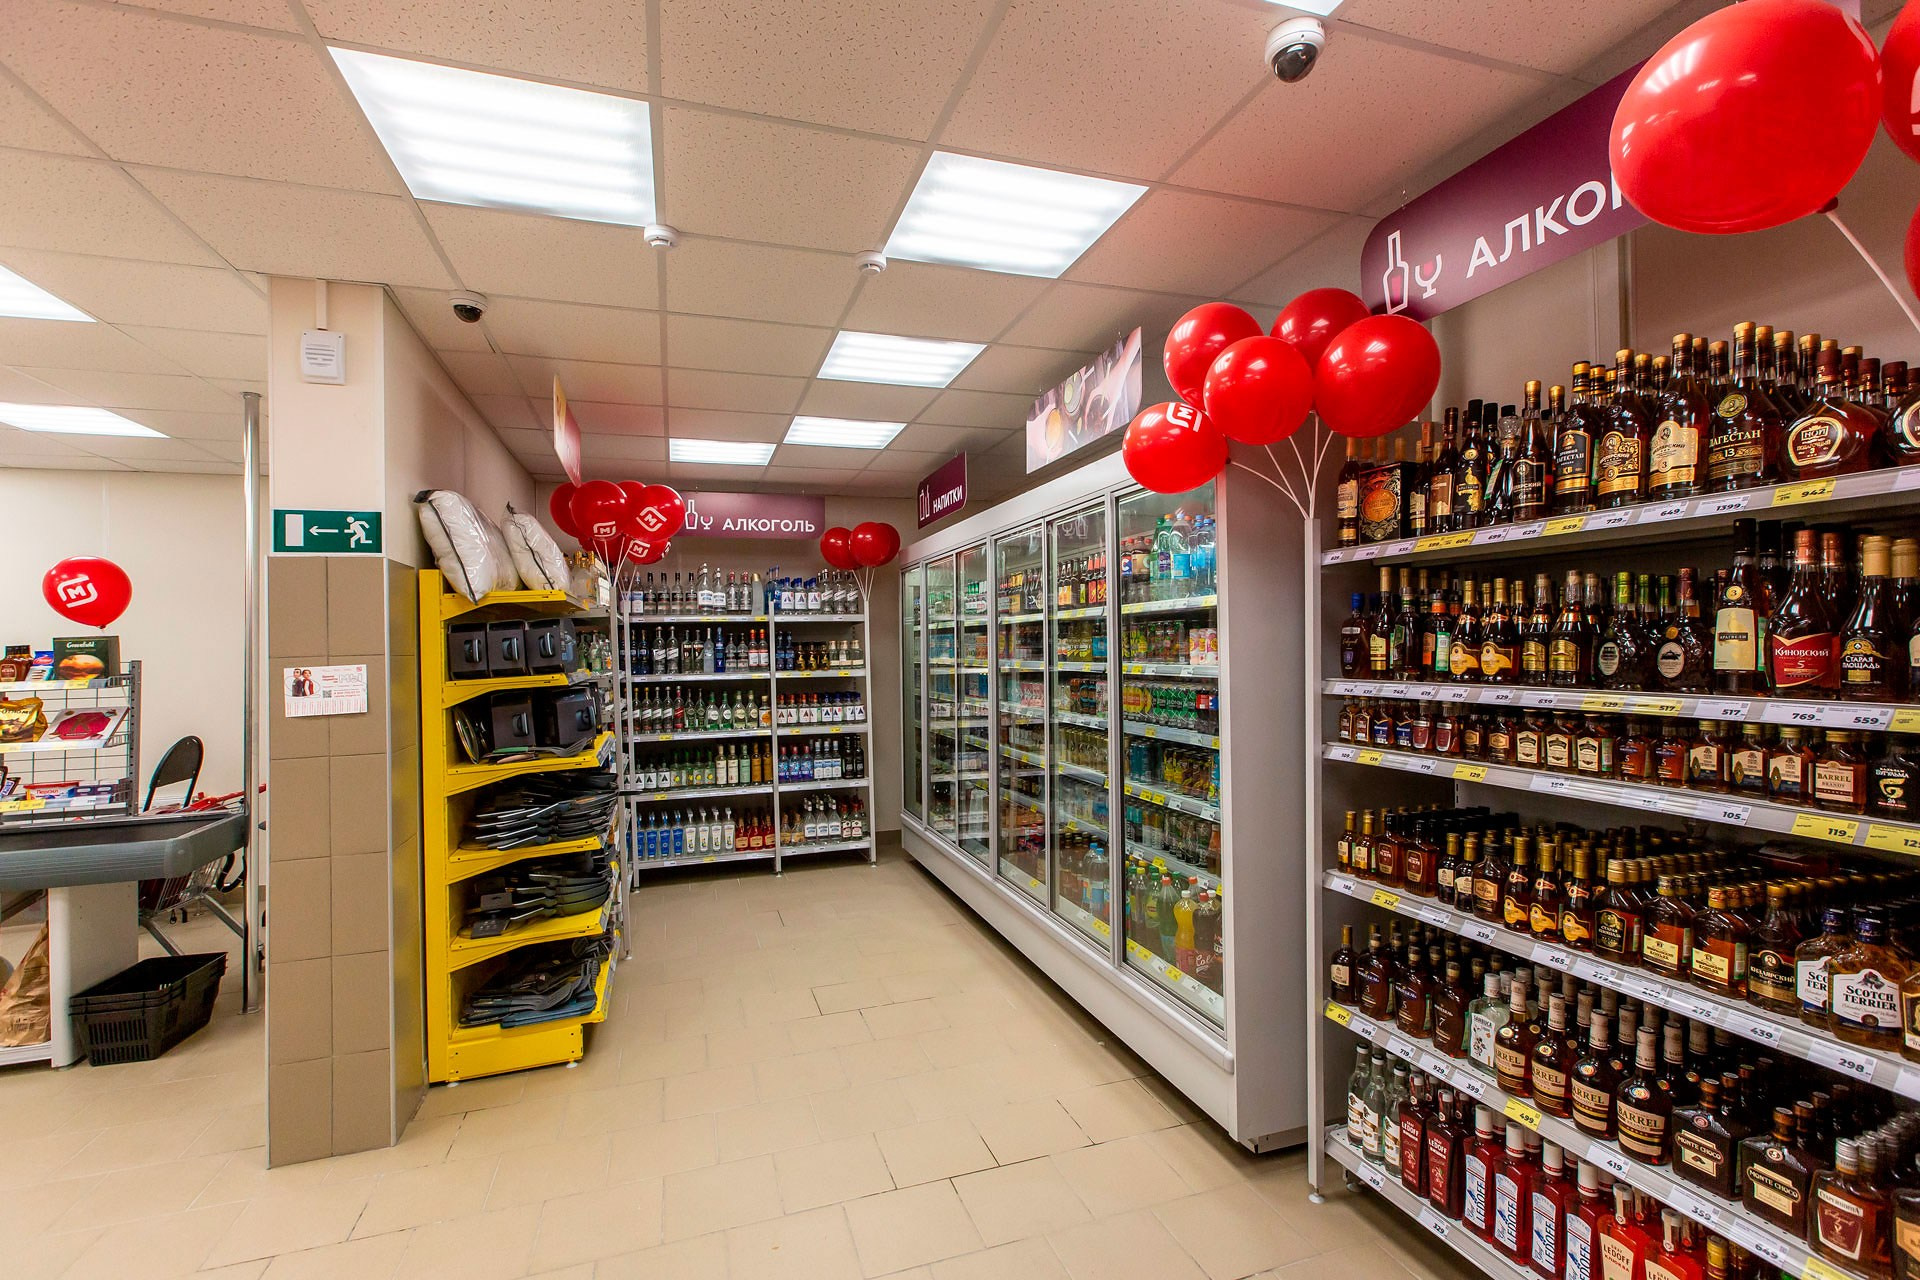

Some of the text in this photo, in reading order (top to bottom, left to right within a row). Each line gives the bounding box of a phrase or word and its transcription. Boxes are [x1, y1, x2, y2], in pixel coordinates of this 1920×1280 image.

[1724, 448, 1735, 458] 13
[1801, 488, 1826, 498] 942
[933, 485, 963, 514] НАПИТКИ
[1660, 508, 1680, 517] 649
[1716, 503, 1741, 511] 1399
[722, 517, 815, 533] АЛКОГОЛЬ
[1606, 517, 1623, 525] 729
[1562, 523, 1577, 531] 559
[1775, 647, 1829, 657] КИНОВСКИЙ
[1797, 660, 1805, 669] 5
[1845, 655, 1873, 663] СТАРАЯ
[1842, 661, 1880, 670] ПЛОЩАДЬ
[1721, 708, 1741, 717] 517
[1792, 713, 1815, 721] 769
[1853, 716, 1879, 725] 559
[1817, 772, 1851, 783] BARREL
[1722, 811, 1741, 820] 105
[1828, 828, 1847, 837] 119
[1903, 839, 1920, 848] 12
[1476, 930, 1490, 939] 339
[1550, 955, 1565, 964] 265
[1846, 984, 1894, 1001] SCOTCH
[1843, 993, 1897, 1012] TERRIER
[1692, 1006, 1712, 1018] 275
[1750, 1027, 1773, 1040] 439
[1433, 1064, 1445, 1074] 929
[1838, 1058, 1864, 1072] 298
[1466, 1083, 1480, 1094] 399
[1573, 1084, 1605, 1104] ARREL
[1520, 1112, 1534, 1123] 499
[1401, 1121, 1419, 1137] LEDOFF
[1428, 1139, 1447, 1154] LEDOFF
[1677, 1136, 1721, 1160] MONTE CHOCO
[1606, 1159, 1623, 1172] 419
[1749, 1170, 1798, 1198] MONTE CHOCO
[1476, 1180, 1486, 1222] LEDOFF
[1691, 1206, 1711, 1220] 359
[1507, 1200, 1517, 1244] LEDOFF
[1545, 1218, 1556, 1267] LEDOFF
[1603, 1243, 1630, 1266] LEDOFF
